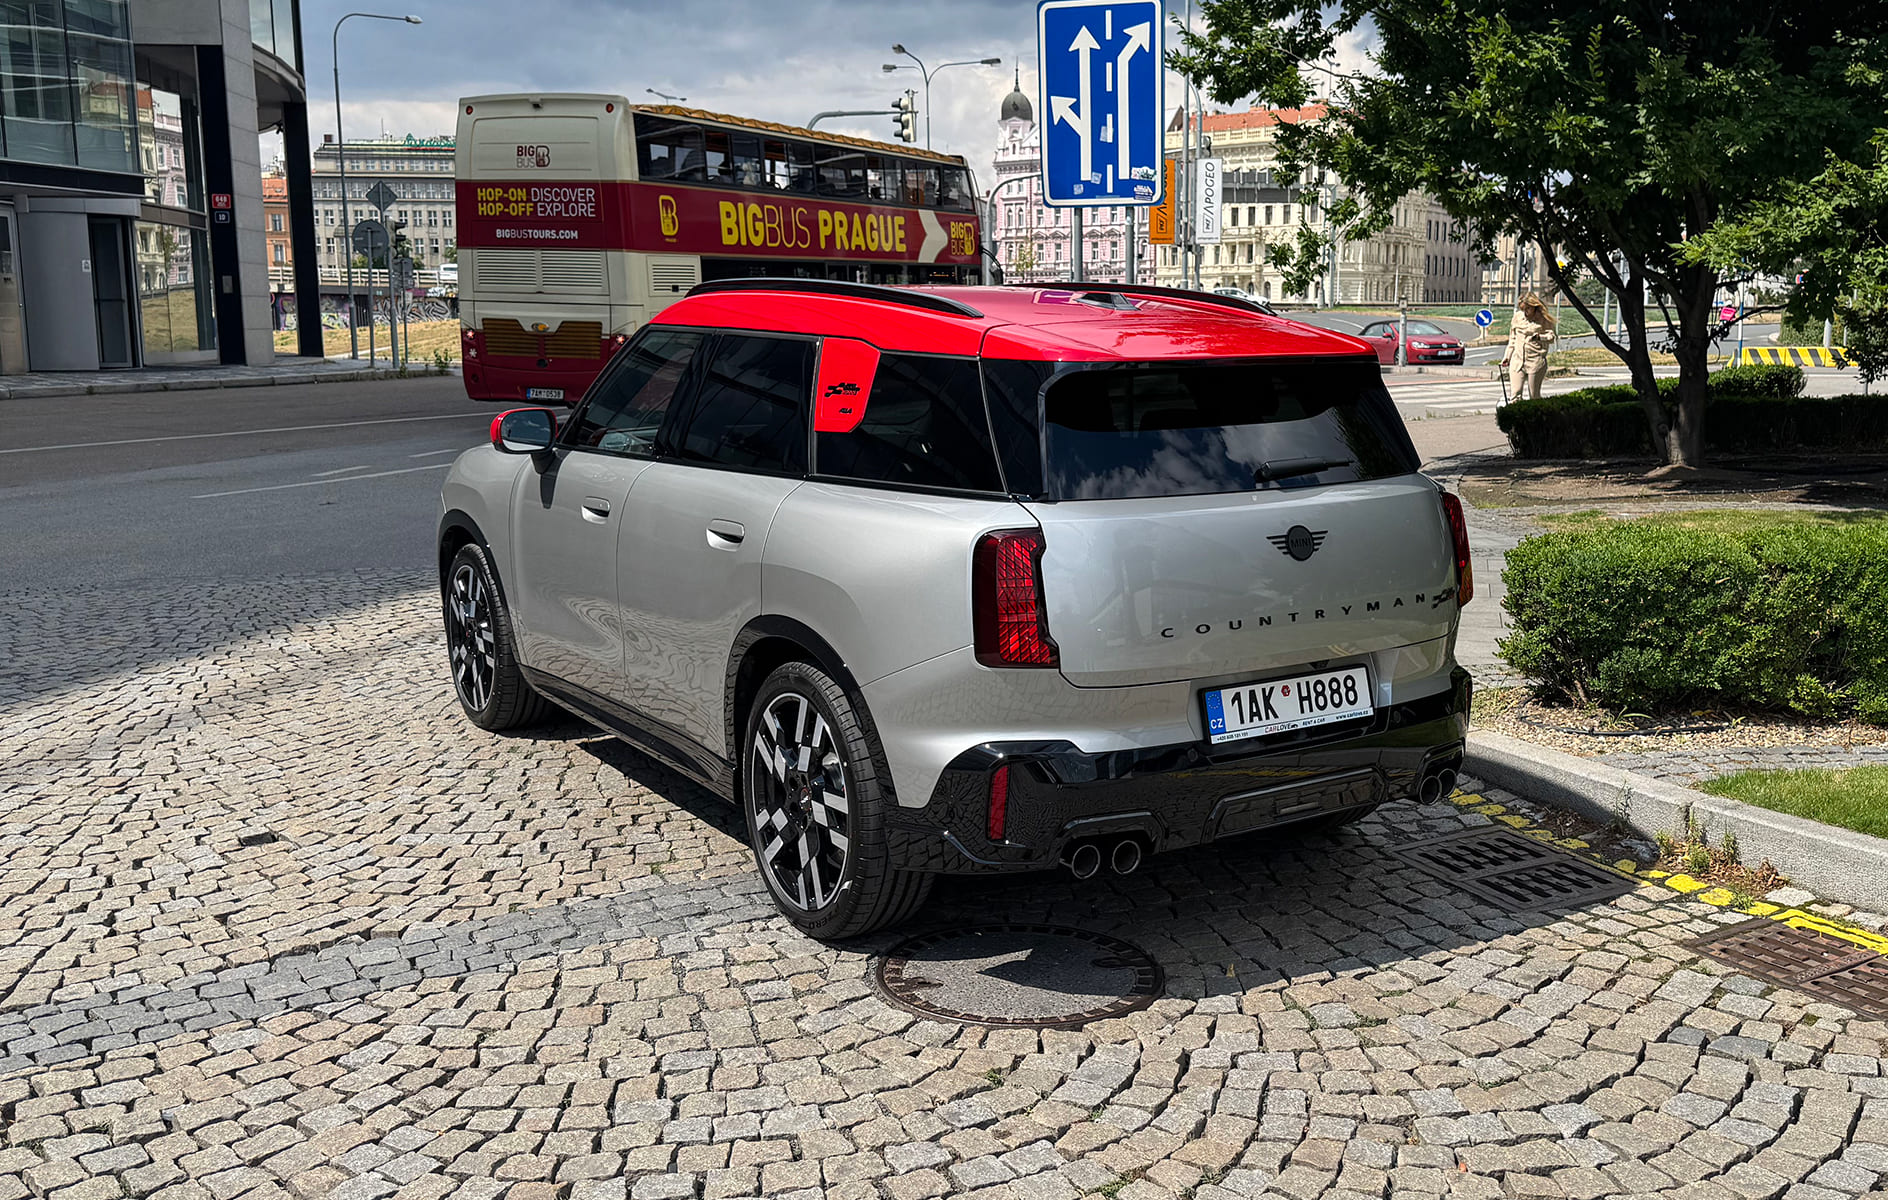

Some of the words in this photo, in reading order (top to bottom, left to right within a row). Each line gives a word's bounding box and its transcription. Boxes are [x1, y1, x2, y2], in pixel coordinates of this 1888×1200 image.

[517, 145, 535, 157] BIG
[517, 157, 535, 168] BUS
[477, 187, 527, 202] HOP-ON
[531, 187, 596, 202] DISCOVER
[1203, 161, 1215, 215] APOGEO
[477, 203, 534, 217] HOP-OFF
[537, 203, 596, 217] EXPLORE
[495, 229, 579, 240] BIGBUSTOURS.COM
[818, 210, 907, 253] PRAGUE
[950, 221, 965, 239] BIG
[951, 239, 965, 256] BUS
[1290, 537, 1310, 549] MINI
[1161, 593, 1425, 638] COUNTRYMAN
[1231, 686, 1279, 725] 1AK
[1297, 674, 1359, 714] H888
[1210, 718, 1224, 730] CZ
